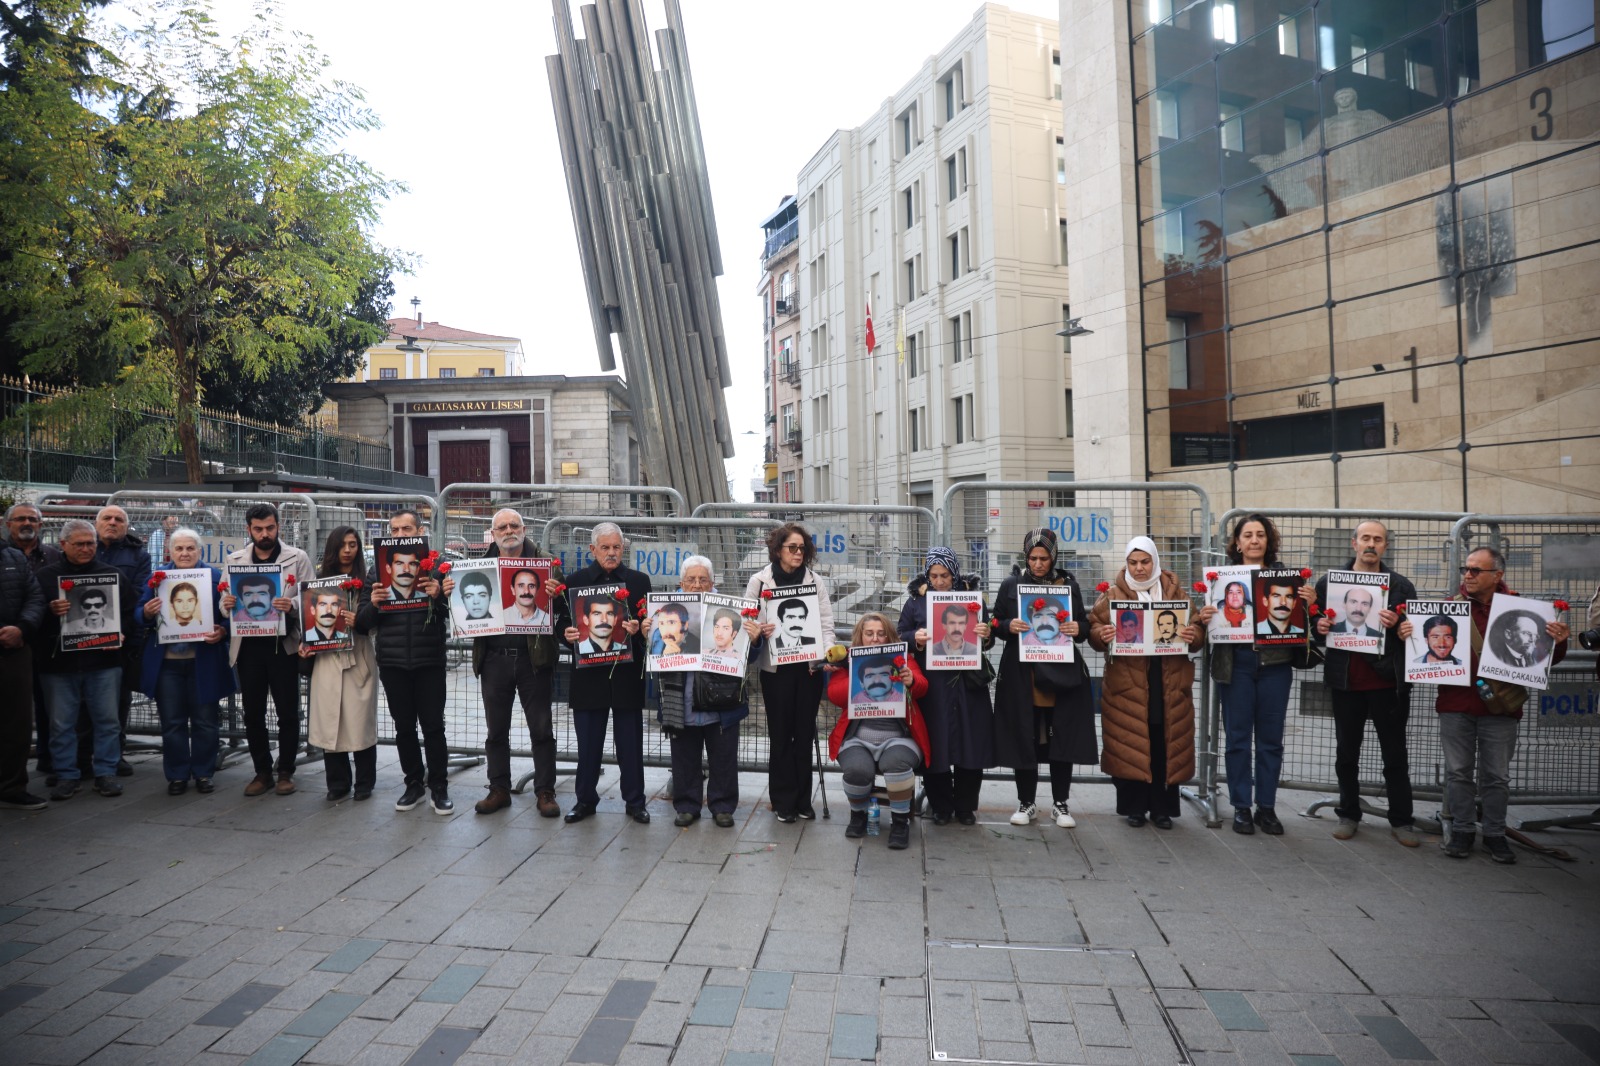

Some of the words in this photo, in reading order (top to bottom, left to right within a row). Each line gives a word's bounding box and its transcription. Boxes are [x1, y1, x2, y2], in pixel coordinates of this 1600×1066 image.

[1530, 86, 1553, 141] 3
[413, 401, 488, 411] GALATASARAY
[491, 400, 523, 410] LİSESİ
[1297, 391, 1321, 409] MÜZE
[1048, 513, 1109, 543] POLİS
[380, 538, 399, 547] AGİT
[399, 537, 424, 546] AKİPA
[811, 529, 846, 554] LİS
[201, 541, 235, 564] LİS
[499, 559, 525, 567] KENAN
[525, 559, 551, 567] BİLGİN
[229, 566, 258, 574] İBRAHİM
[258, 565, 280, 573] DEMİR
[1258, 570, 1277, 578] AGİT
[1277, 569, 1301, 577] AKİPA
[1330, 572, 1355, 583] RIDVAN
[307, 581, 324, 589] AGİT
[1019, 586, 1047, 594] İBRAHİM
[1048, 586, 1069, 595] DEMİR
[577, 588, 596, 597] AGİT
[772, 589, 797, 598] LEYMAN
[932, 594, 954, 602] FEHMİ
[704, 595, 731, 607] MURAT
[731, 599, 756, 609] YILDIZ
[1409, 602, 1440, 614] HASAN
[1442, 603, 1469, 615] OCAK
[236, 628, 276, 636] KAYBEDİLDİ
[1334, 638, 1378, 648] KAYBEDİLD
[852, 647, 882, 657] İBRAHİM
[882, 644, 905, 653] DEMİR
[777, 652, 817, 664] KAYBEDİLDİ
[1025, 653, 1065, 661] KAYBEDİLDİ
[702, 662, 739, 674] AYBEDİLDİ
[1408, 667, 1466, 681] KAYBEDİLDİ
[1481, 665, 1511, 679] KAREKİN
[1511, 671, 1547, 686] ÇAKALYAN
[853, 708, 896, 718] KAYBEDİLDİ
